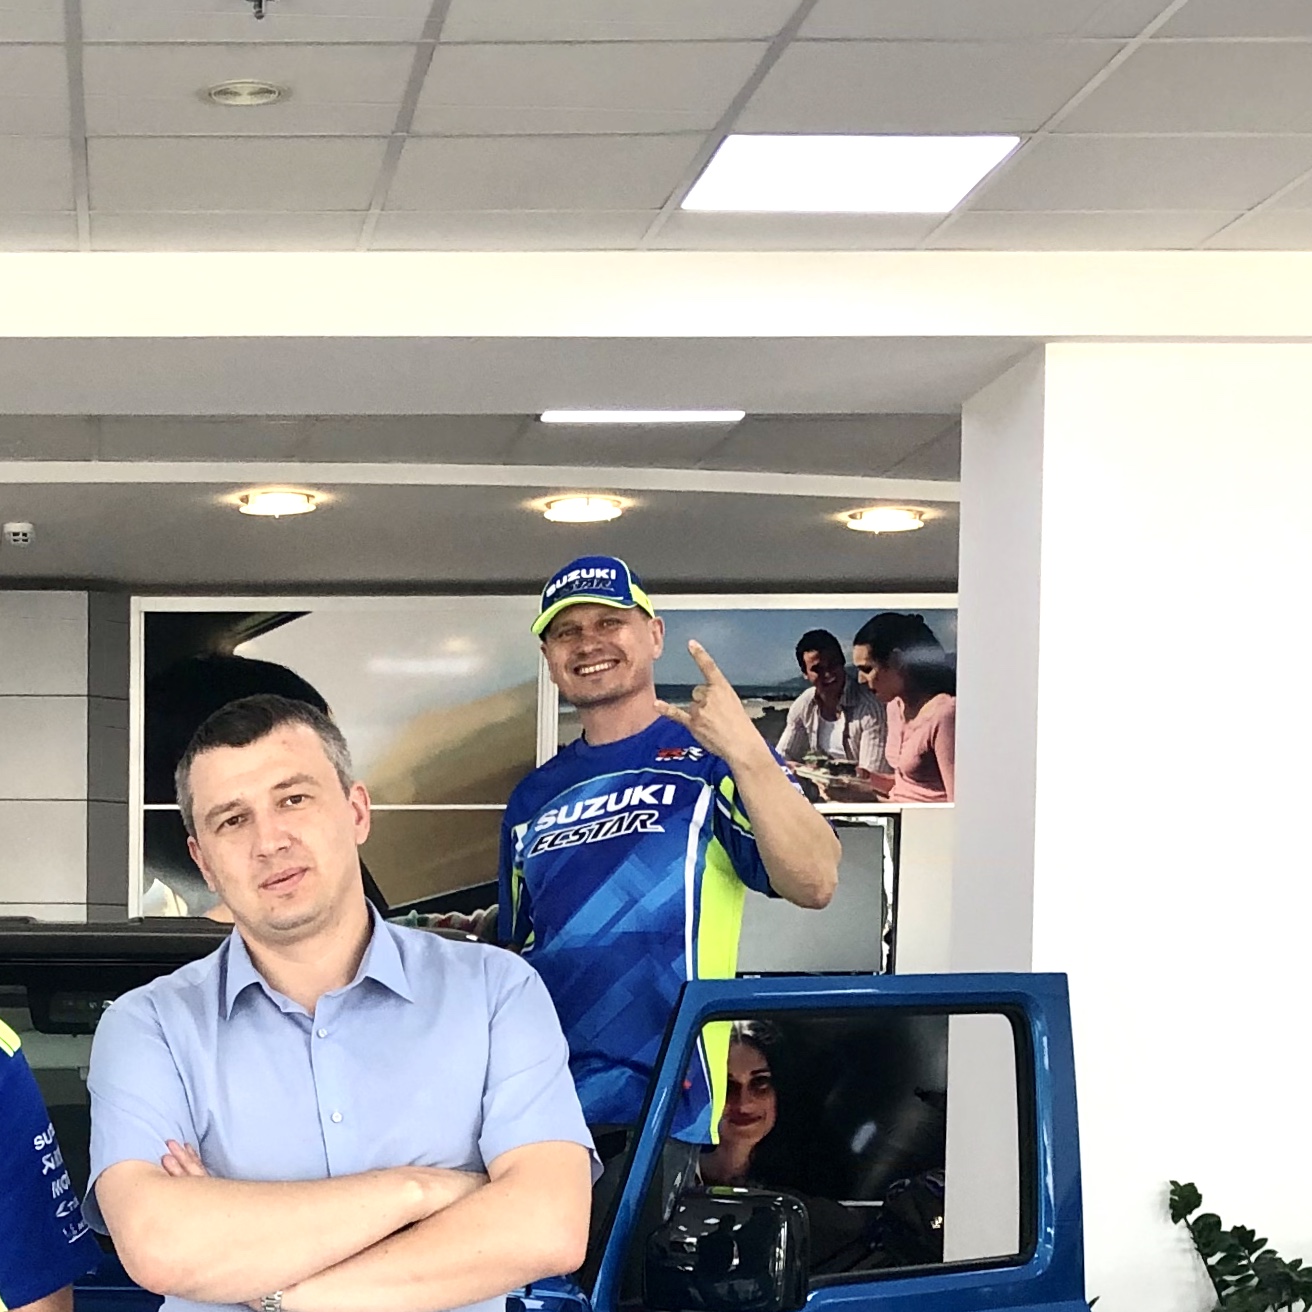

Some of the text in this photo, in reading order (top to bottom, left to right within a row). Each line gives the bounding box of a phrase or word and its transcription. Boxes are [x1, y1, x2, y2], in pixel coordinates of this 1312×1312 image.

[545, 567, 617, 598] SUZUKI
[534, 784, 677, 832] SUZUKI
[527, 810, 665, 858] ECSTAR
